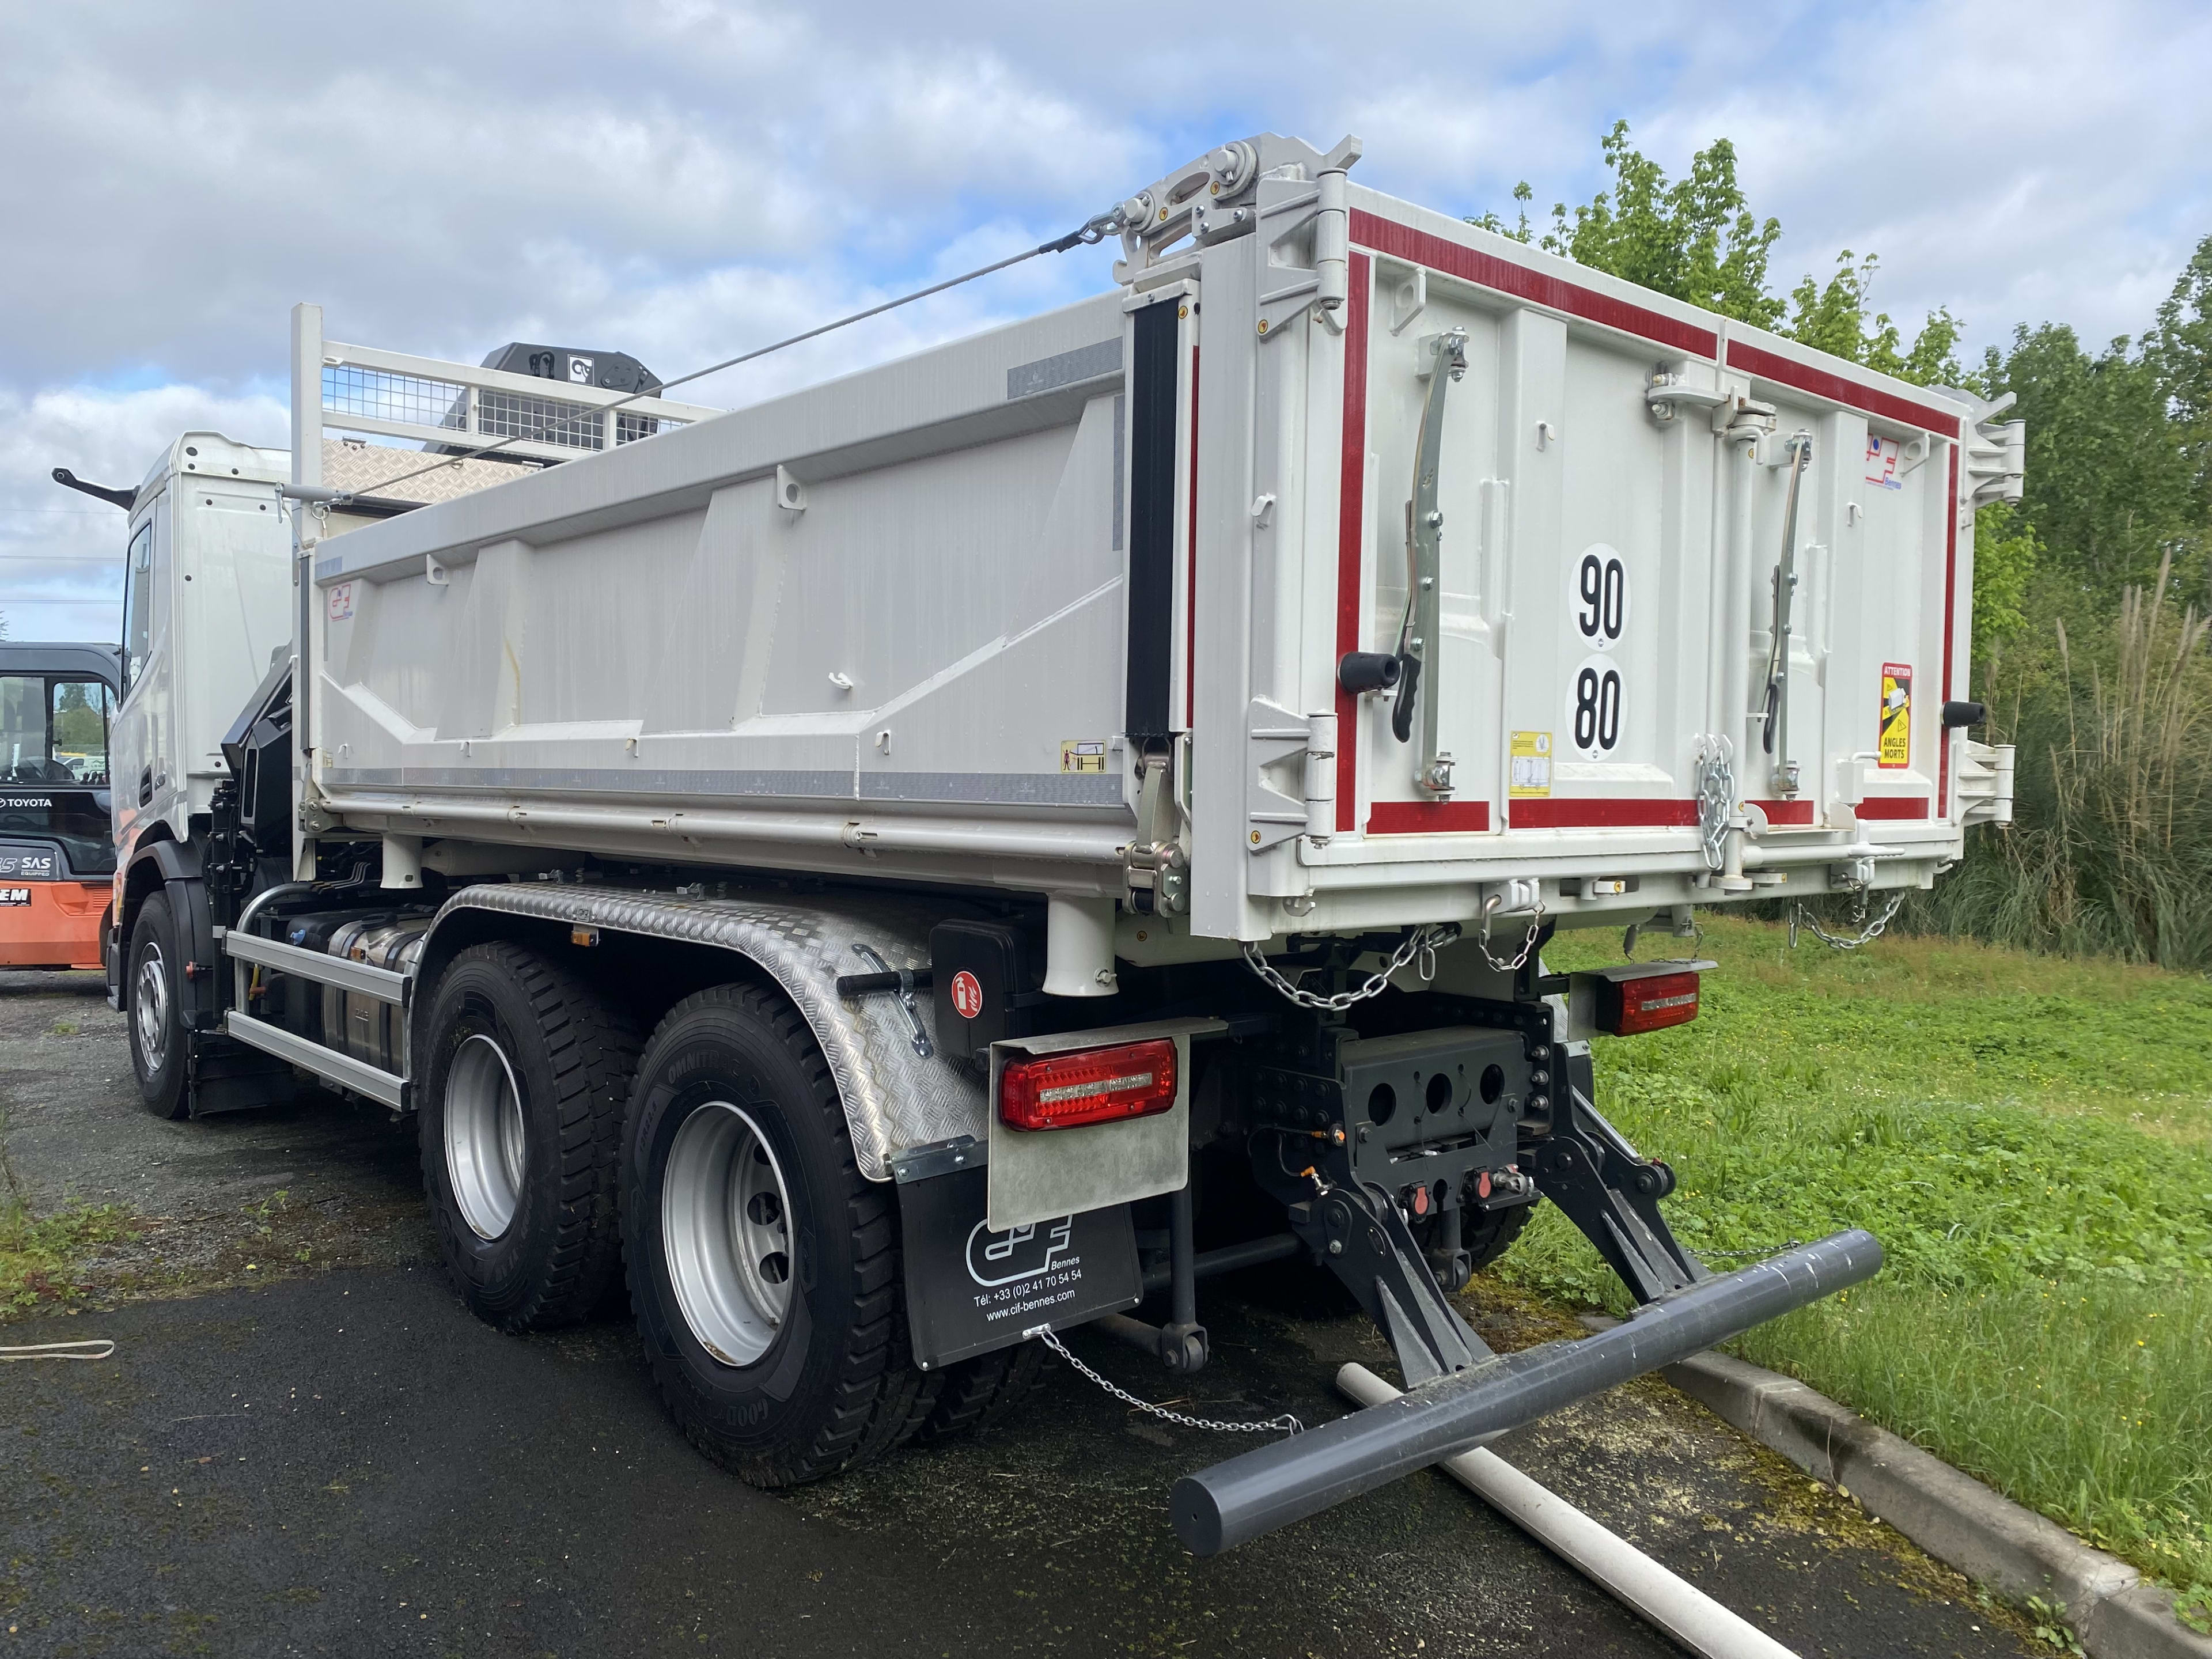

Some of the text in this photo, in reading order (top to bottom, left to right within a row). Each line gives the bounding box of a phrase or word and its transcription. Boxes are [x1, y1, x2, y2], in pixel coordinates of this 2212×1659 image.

[1580, 554, 1623, 639] 90
[1884, 666, 1911, 677] ATTENTION
[1575, 667, 1620, 750] 80
[1884, 737, 1906, 748] ANGLES
[1884, 749, 1904, 759] MORTS
[7, 798, 52, 807] TOYOTA
[21, 857, 51, 869] SAS
[1051, 1256, 1080, 1270] Bennes
[974, 1268, 1082, 1307] Tél: +33 (0)2 41 70 54 54
[986, 1290, 1075, 1321] www.cif-bennes.com
